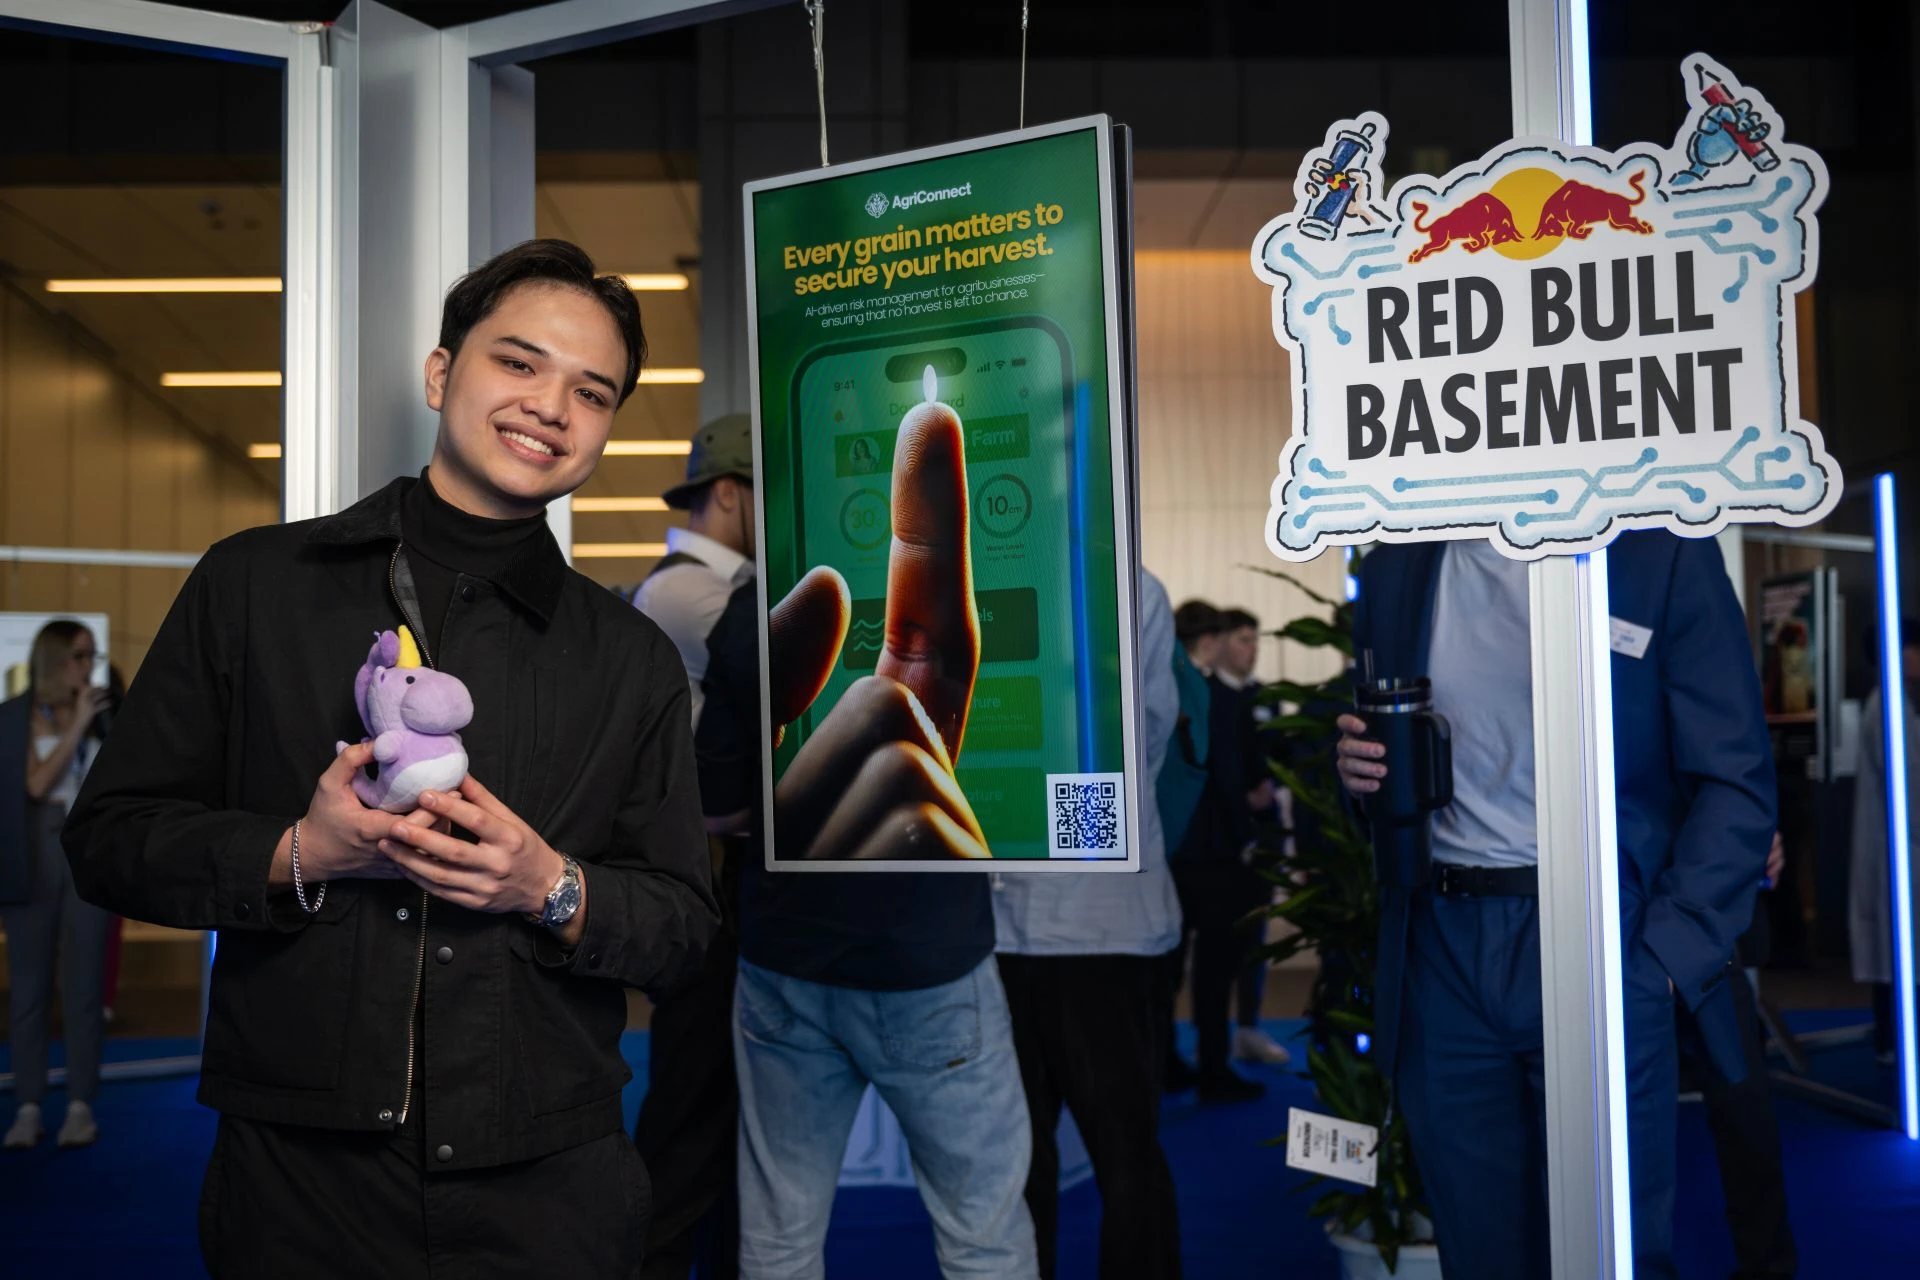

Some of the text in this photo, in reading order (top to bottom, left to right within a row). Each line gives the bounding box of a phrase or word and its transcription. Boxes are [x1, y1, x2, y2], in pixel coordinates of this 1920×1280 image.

[892, 182, 972, 209] AgriConnect
[784, 203, 1064, 269] Every grain matters to
[794, 232, 1054, 295] secure your harvest.
[805, 303, 848, 317] AI-driven
[849, 298, 865, 310] risk
[866, 287, 939, 306] management
[941, 285, 956, 296] for
[821, 288, 1029, 328] ensuring that no harvest is left to chance.
[1366, 250, 1714, 364] RED BULL
[833, 379, 855, 391] 9:41
[1346, 347, 1743, 461] BASEMENT
[971, 429, 1016, 447] Farm
